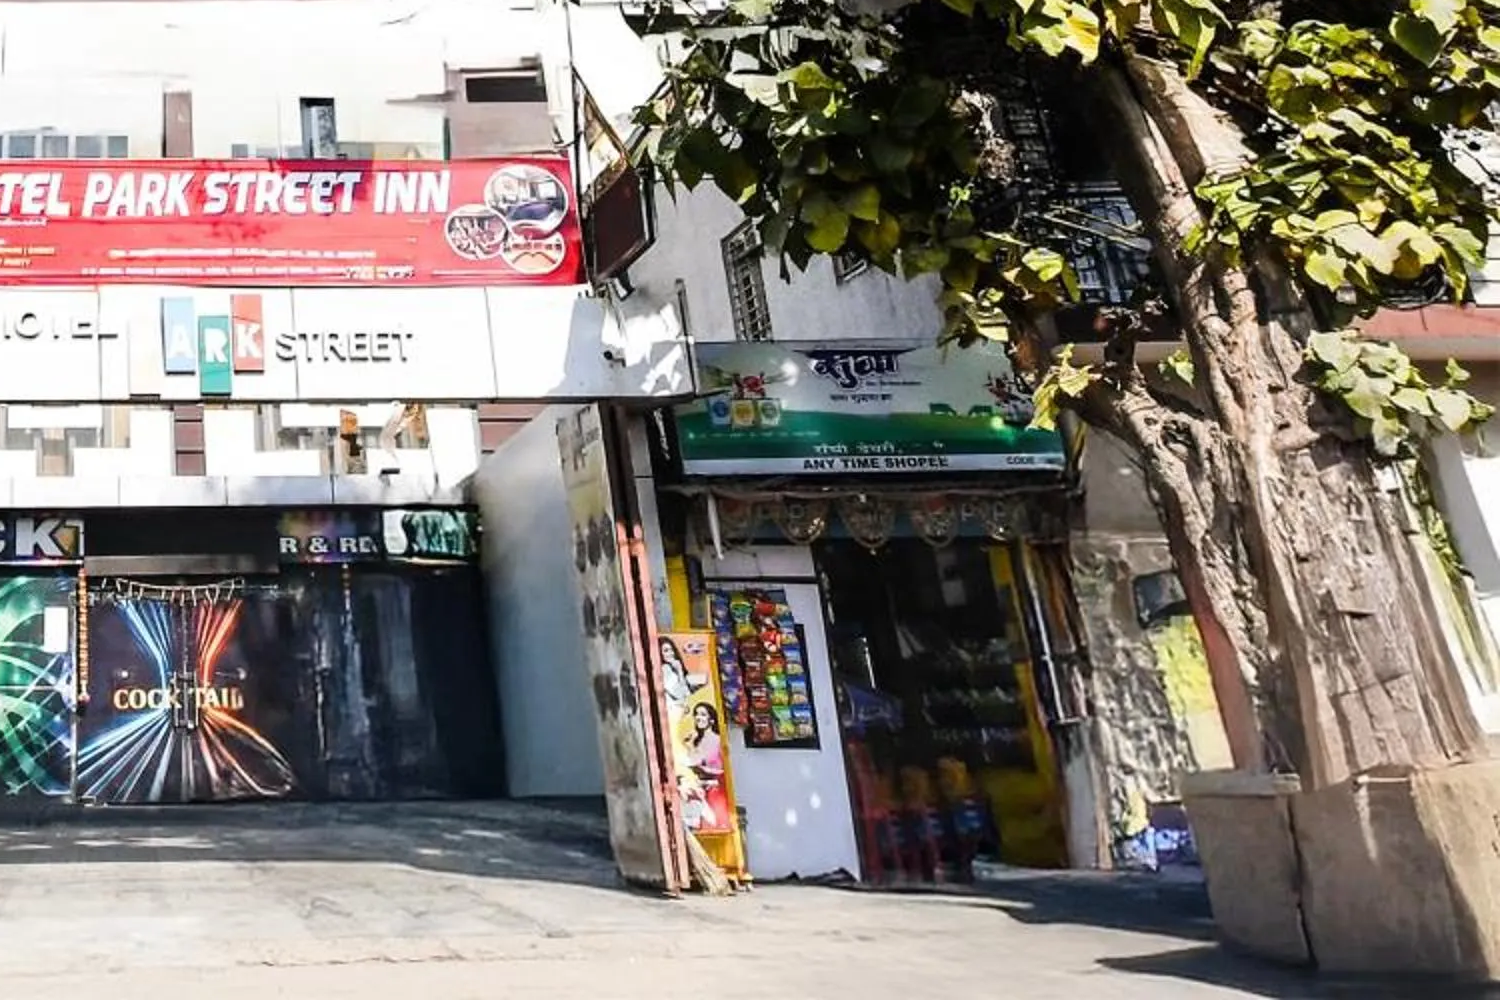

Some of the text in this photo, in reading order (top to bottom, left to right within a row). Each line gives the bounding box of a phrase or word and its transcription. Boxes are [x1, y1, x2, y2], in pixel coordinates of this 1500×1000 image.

[81, 171, 195, 217] PARK
[203, 171, 363, 215] STREET
[374, 171, 451, 214] INN
[132, 321, 264, 364] ARK
[276, 331, 414, 363] STREET
[803, 458, 836, 470] ANY
[840, 457, 880, 469] TIME
